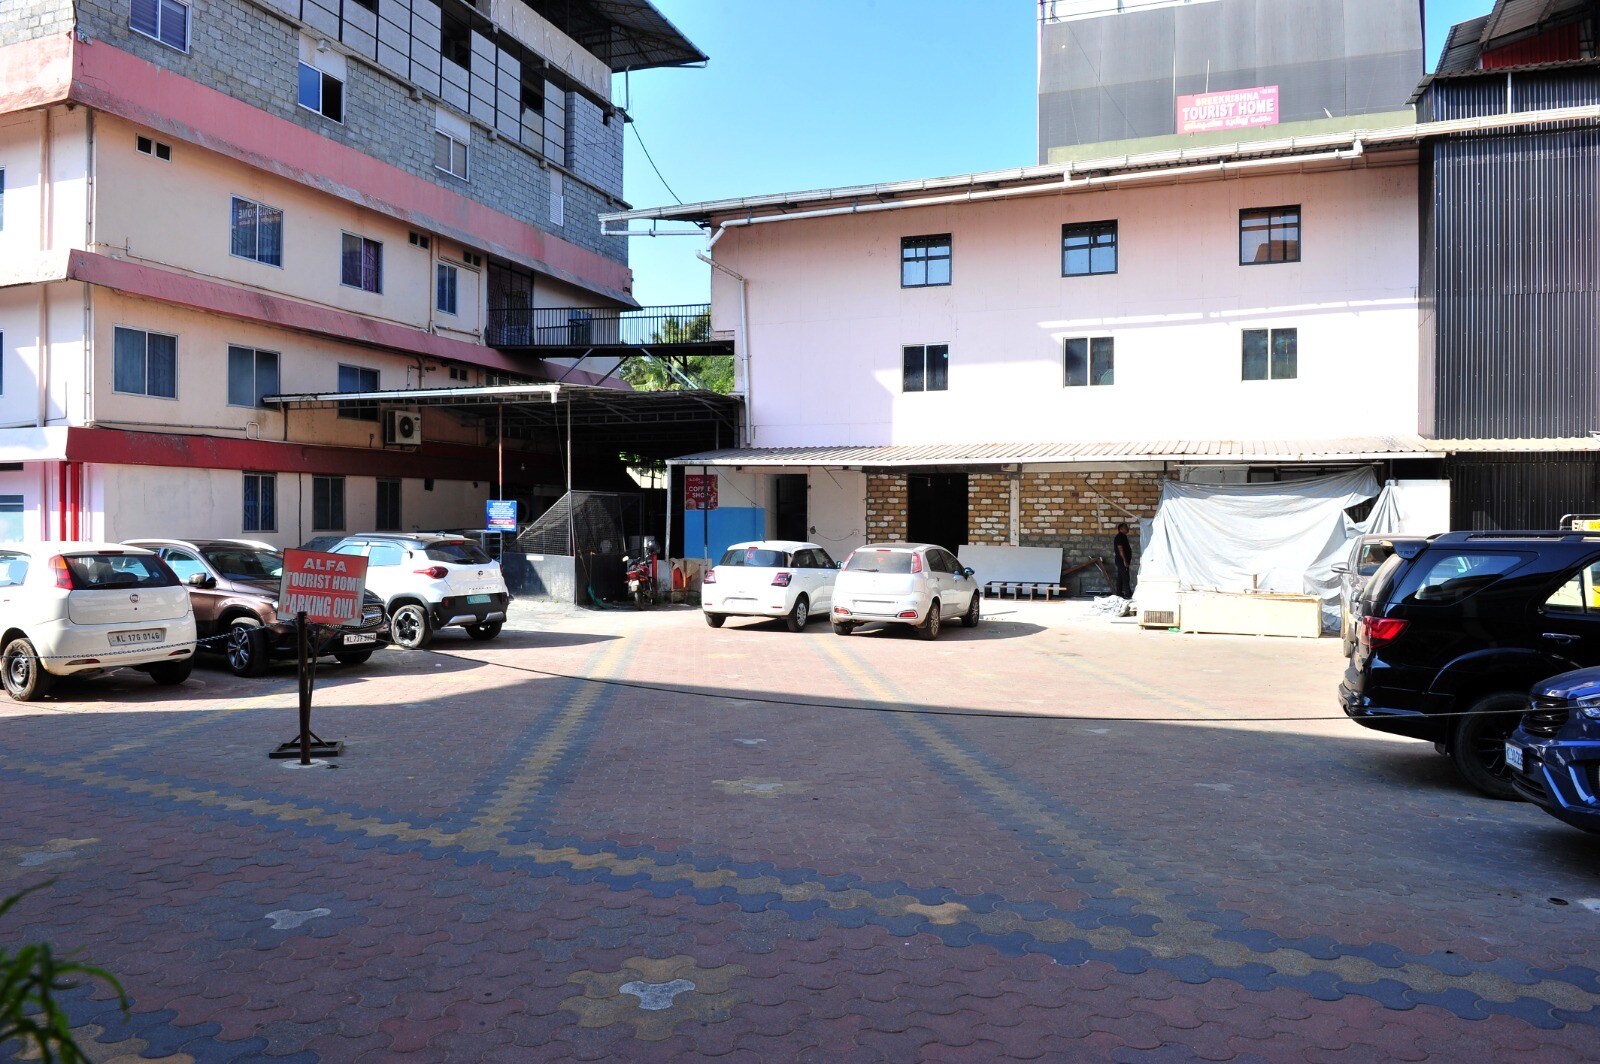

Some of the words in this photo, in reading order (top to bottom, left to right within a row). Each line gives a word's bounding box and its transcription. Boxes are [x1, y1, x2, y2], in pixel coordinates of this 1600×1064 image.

[1182, 103, 1235, 120] TOURIST
[1238, 98, 1274, 115] HOME
[303, 558, 347, 573] ALFA
[286, 571, 332, 589] TOURIST
[282, 593, 332, 618] PARKING
[333, 596, 363, 619] ONLY
[116, 635, 126, 643] KL
